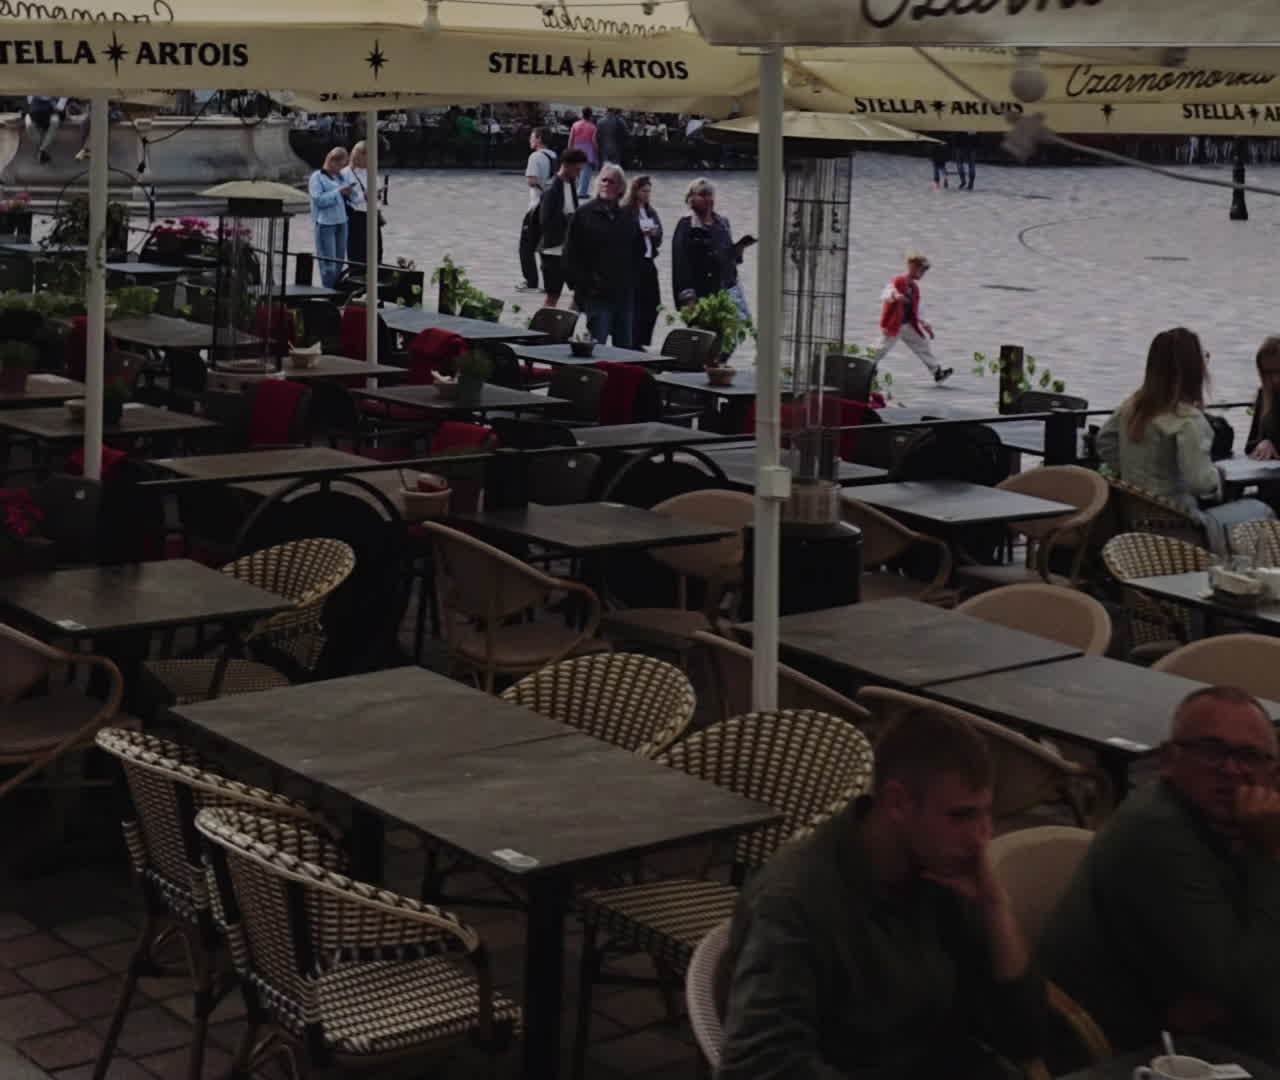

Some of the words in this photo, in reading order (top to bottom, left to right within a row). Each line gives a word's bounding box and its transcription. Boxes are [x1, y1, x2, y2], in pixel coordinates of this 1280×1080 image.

[135, 41, 249, 67] ARTOIS
[488, 51, 575, 77] STELLA
[601, 59, 689, 80] ARTOIS
[854, 98, 927, 114] STELLA
[1182, 103, 1245, 121] STELLA
